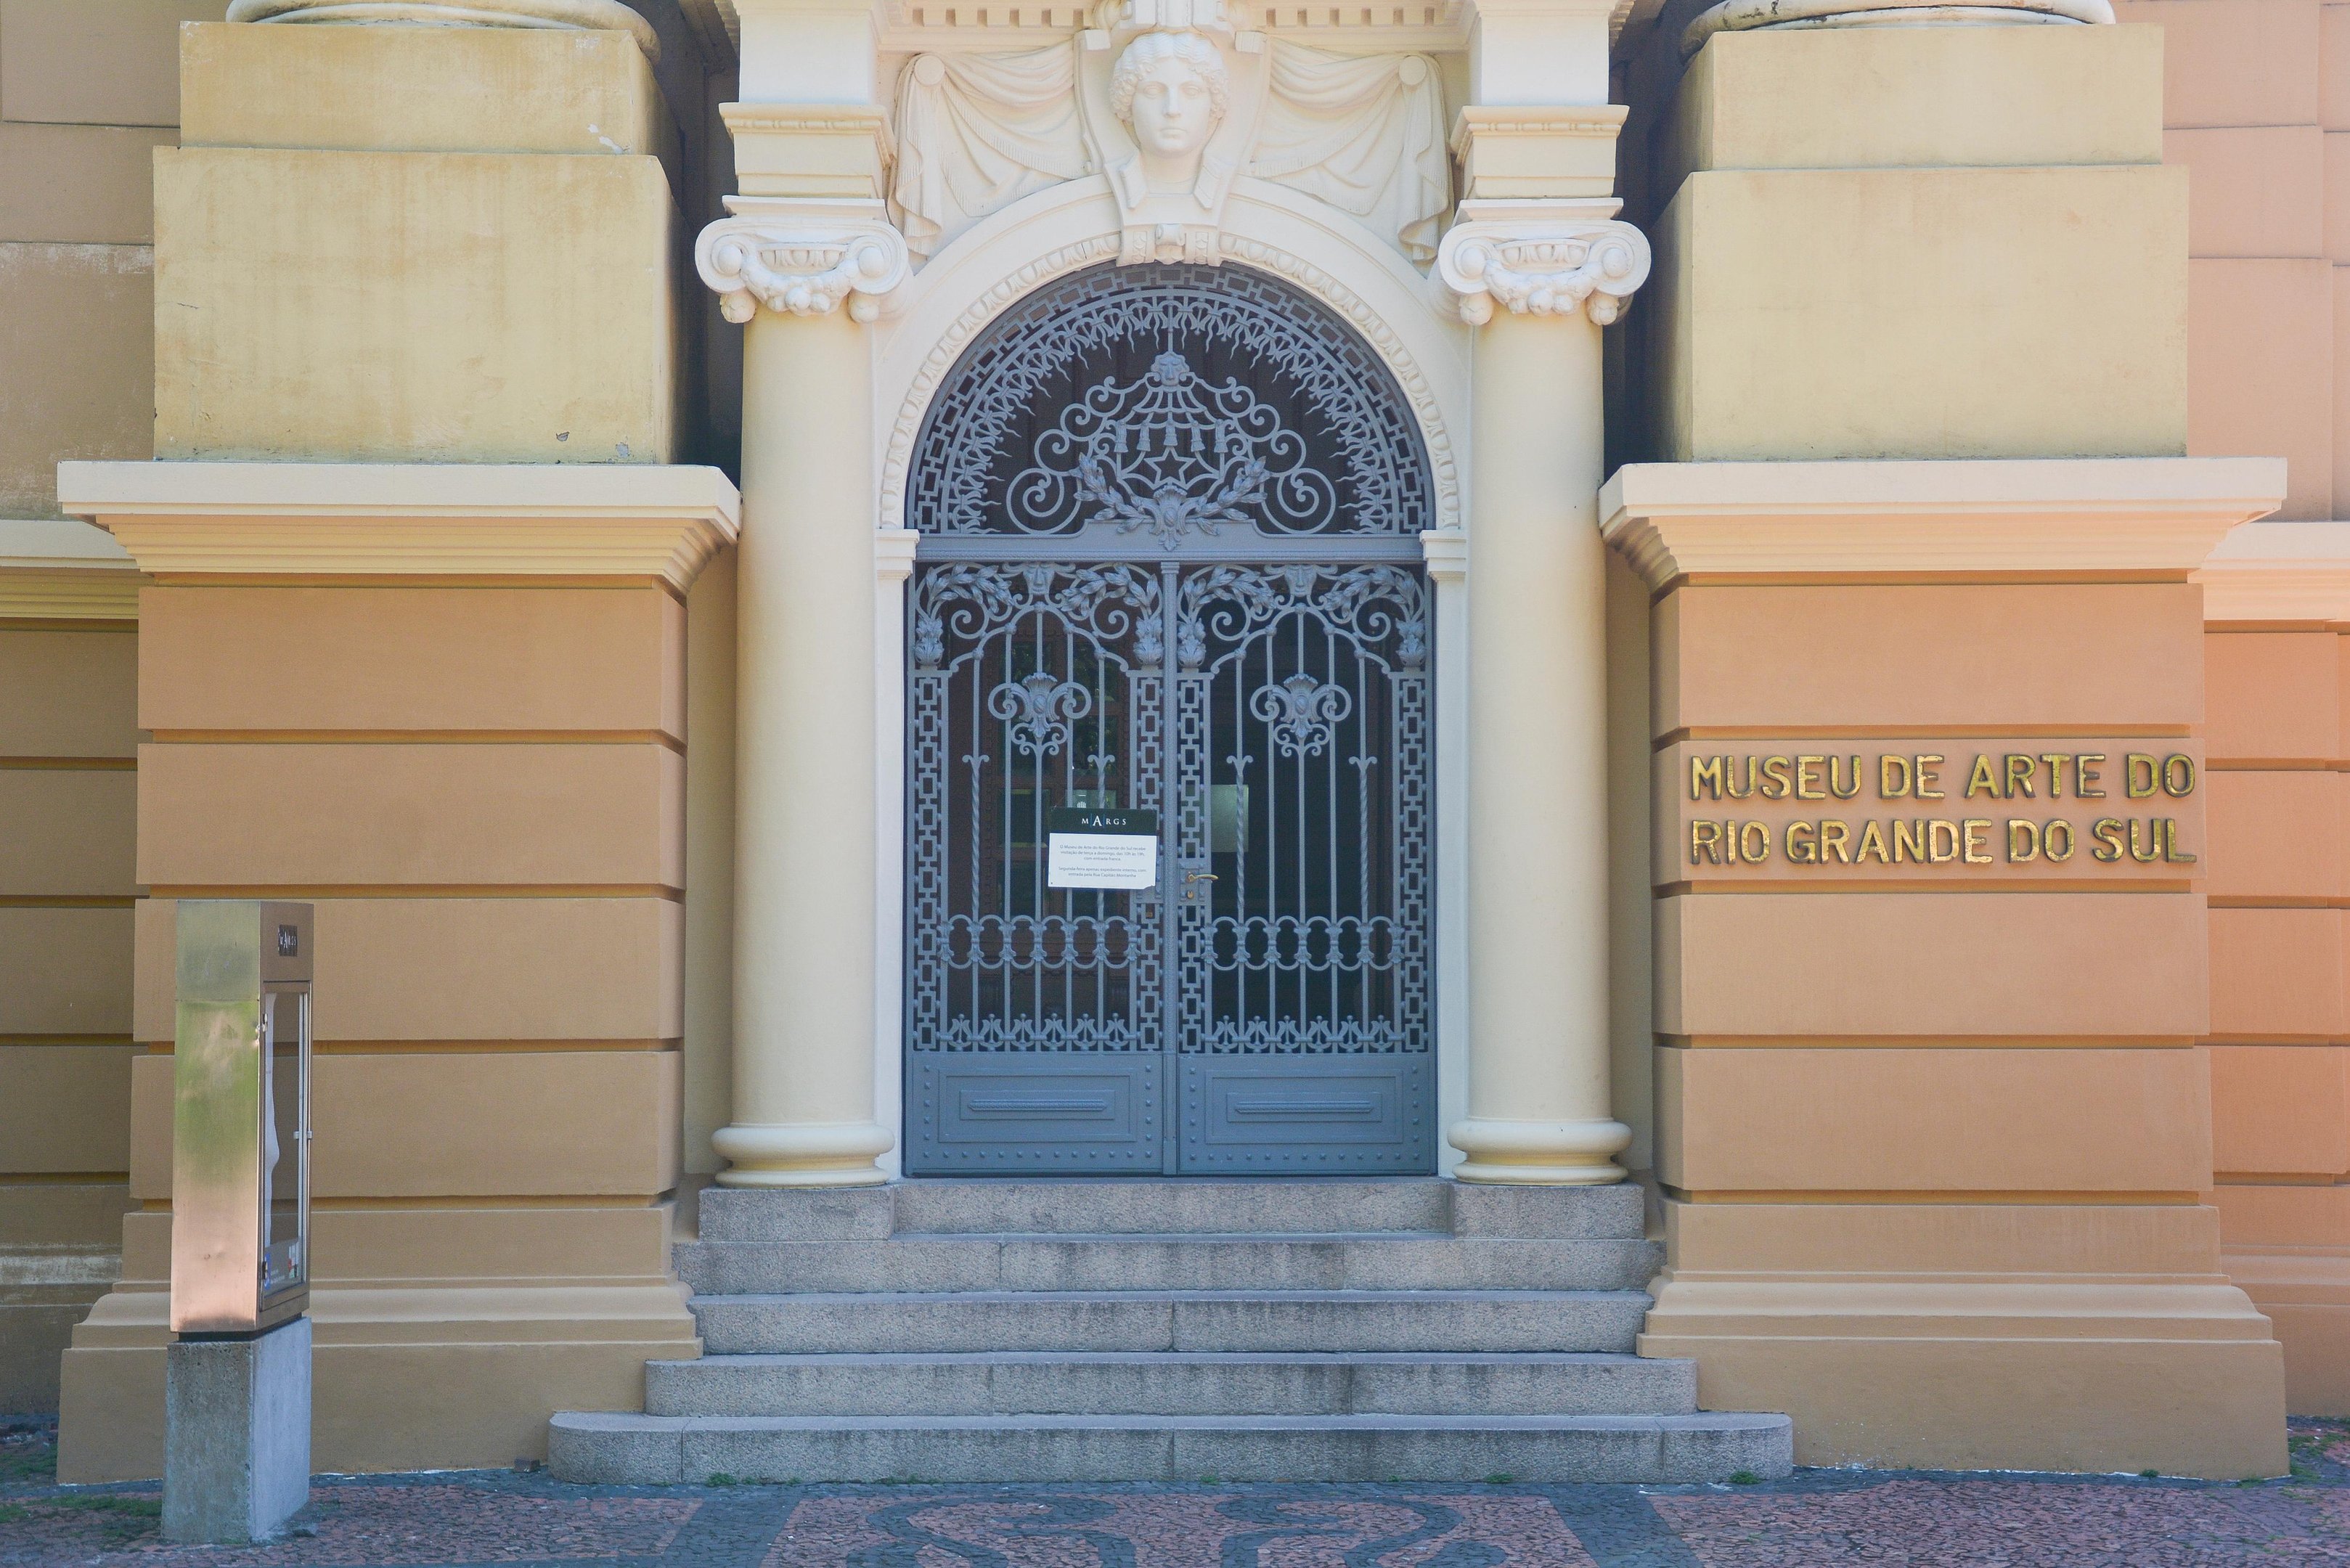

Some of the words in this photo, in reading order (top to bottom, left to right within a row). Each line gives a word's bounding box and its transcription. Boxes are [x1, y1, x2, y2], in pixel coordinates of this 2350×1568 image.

[1692, 755, 1861, 799] MUSEU
[1880, 755, 1945, 799] DE
[1965, 754, 2106, 799] ARTE
[2126, 754, 2195, 799] DO
[1082, 815, 1126, 826] MARGS
[1692, 820, 1771, 865] RIO
[1785, 819, 1993, 865] GRANDE
[2007, 818, 2075, 863] DO
[2092, 817, 2197, 863] SUL
